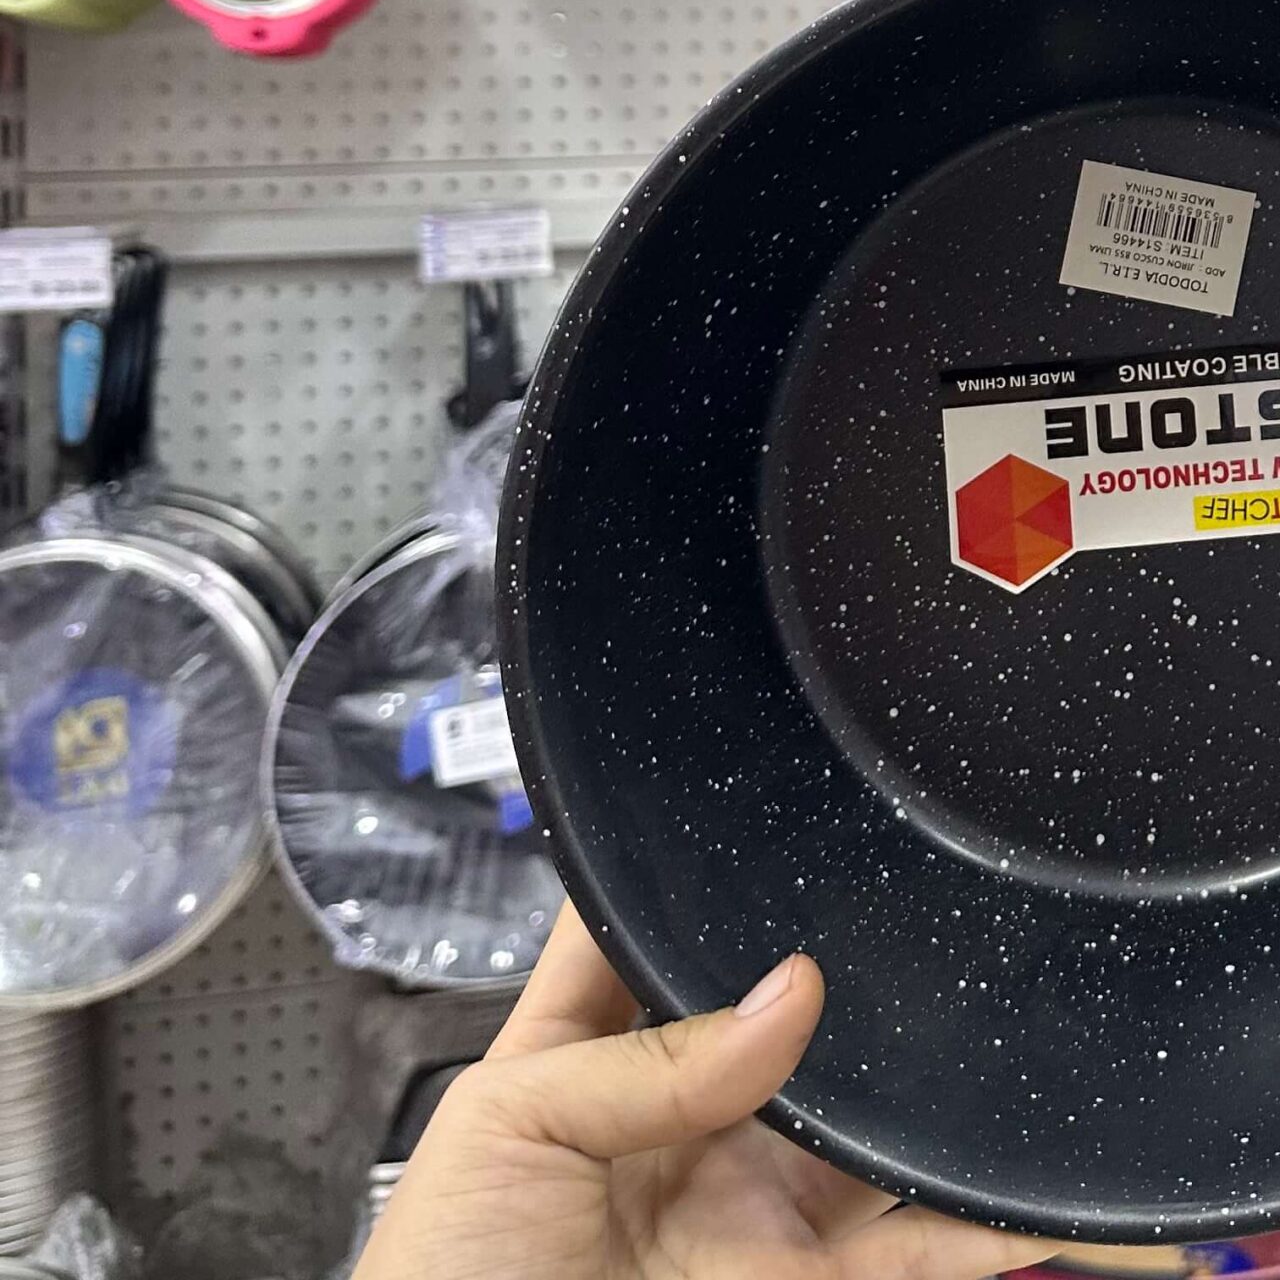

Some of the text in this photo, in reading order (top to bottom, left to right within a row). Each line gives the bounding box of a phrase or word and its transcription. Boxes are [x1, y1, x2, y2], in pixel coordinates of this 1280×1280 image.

[1125, 181, 1215, 208] MADE IN CHINA
[1113, 232, 1163, 252] S14466
[1114, 249, 1131, 260] 855
[1133, 252, 1166, 266] CUSCO
[1166, 259, 1195, 272] JIRON
[1145, 269, 1209, 294] TODODIA
[1118, 356, 1227, 383] COATING
[956, 370, 1076, 392] MADE IN CHINA
[1079, 457, 1265, 496] TECHNOLOGY
